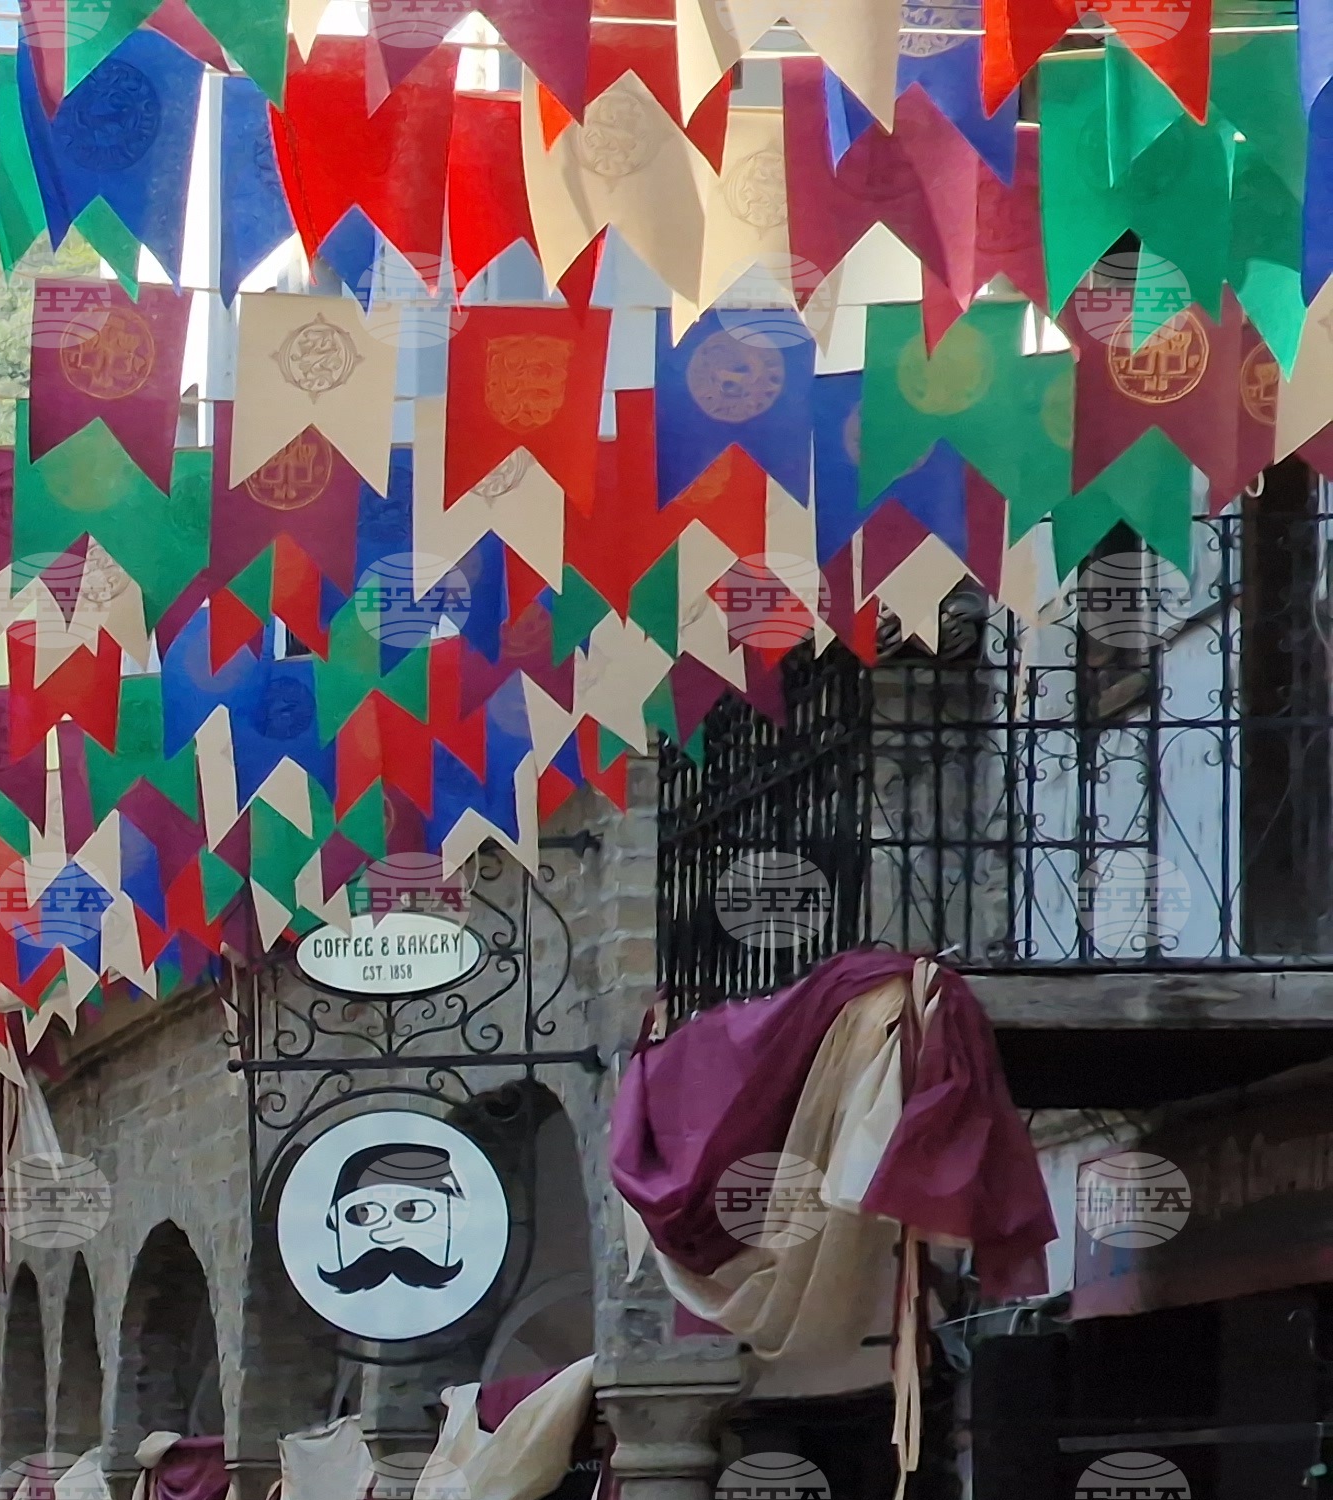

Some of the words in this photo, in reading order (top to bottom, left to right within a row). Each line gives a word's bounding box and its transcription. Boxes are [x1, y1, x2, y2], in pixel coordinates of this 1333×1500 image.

[313, 936, 374, 958] COFFEE
[397, 932, 460, 956] BAKERY
[390, 964, 413, 980] 1858
